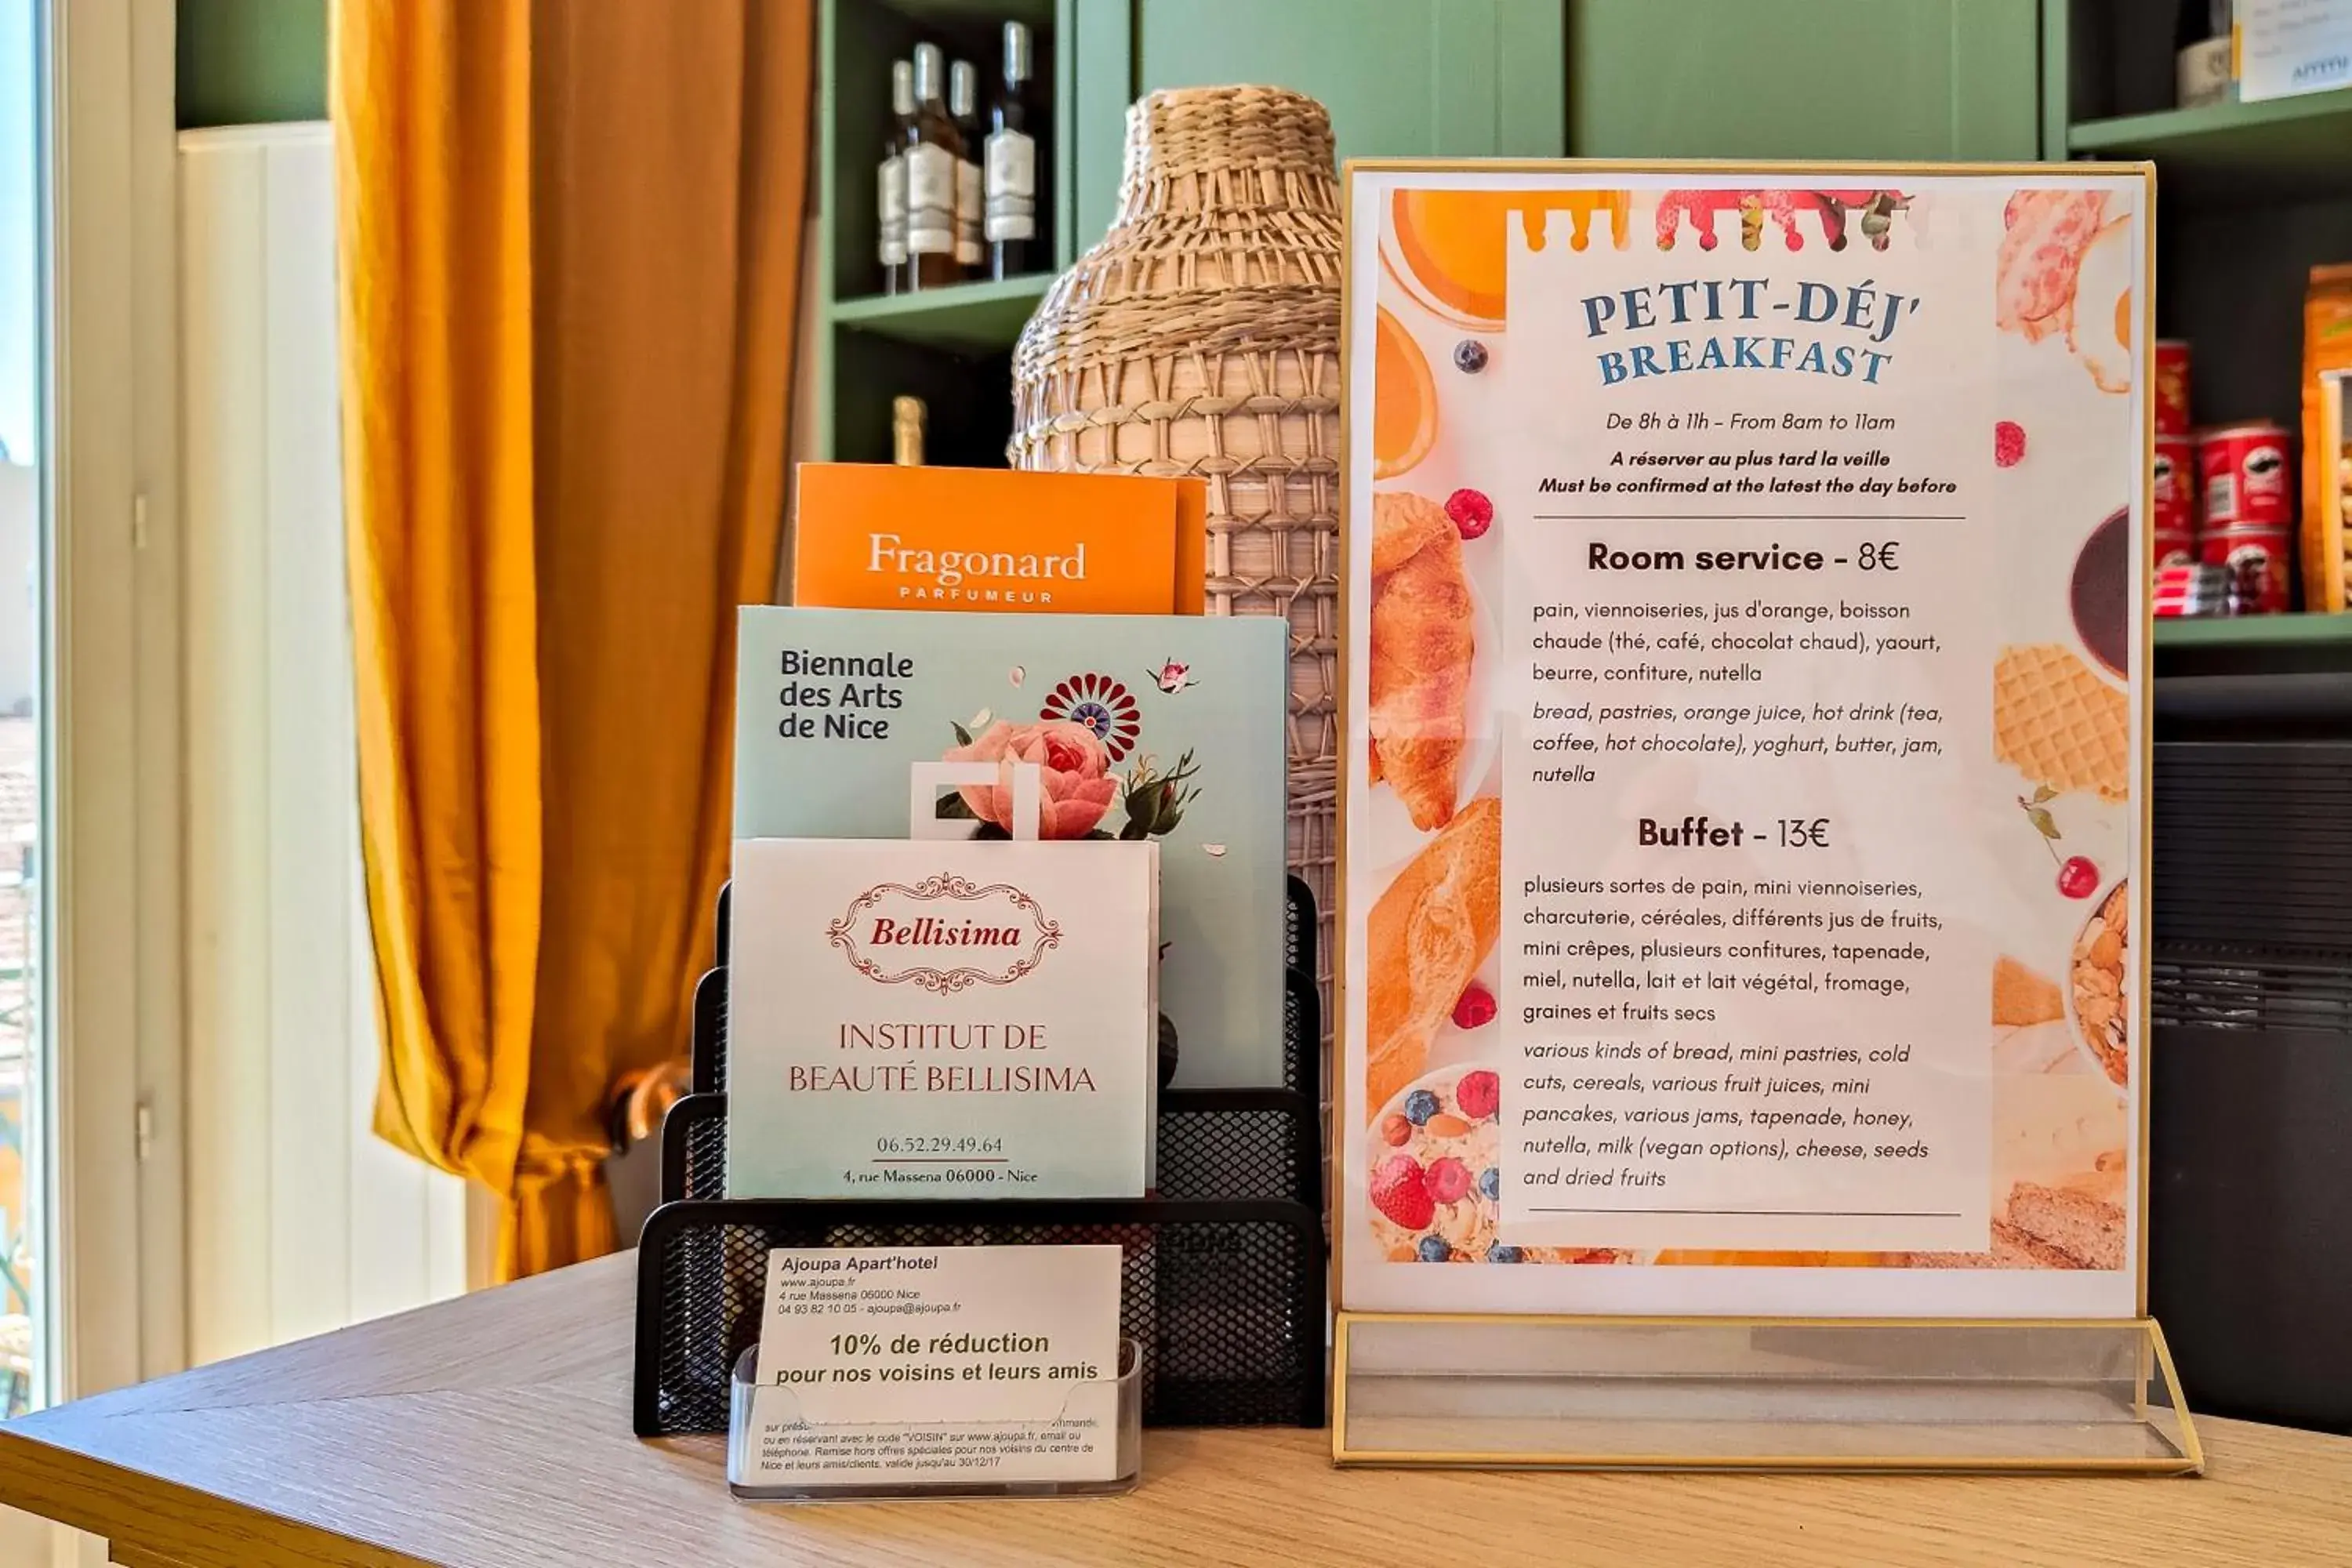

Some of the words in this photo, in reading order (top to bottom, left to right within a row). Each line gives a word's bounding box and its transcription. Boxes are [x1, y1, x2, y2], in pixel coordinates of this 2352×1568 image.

[1597, 336, 1893, 387] BREAKFAST
[1606, 412, 1632, 430] De
[1638, 412, 1661, 430] 8h
[1667, 413, 1679, 430] à
[1686, 412, 1708, 430] 11h
[1730, 412, 1776, 430] From
[1781, 412, 1823, 430] 8am
[1829, 414, 1848, 430] to
[1854, 412, 1895, 430] 11am
[1610, 451, 1624, 466] A
[1628, 451, 1705, 466] réserver
[1708, 455, 1732, 466] au
[1734, 450, 1773, 470] plus
[1778, 450, 1818, 466] tard
[1820, 450, 1838, 466] la
[1843, 450, 1890, 466] veille
[1537, 477, 1585, 493] Must
[1588, 477, 1612, 492] be
[1616, 477, 1710, 493] confirmed
[1712, 479, 1733, 492] at
[1736, 477, 1765, 492] the
[1769, 477, 1822, 493] latest
[1825, 477, 1854, 493] the
[1859, 477, 1893, 497] day
[1896, 477, 1957, 493] before
[867, 533, 1087, 588] Fragonard
[1588, 542, 1684, 570] Room
[1694, 543, 1824, 571] service
[1857, 541, 1900, 571] 8€
[898, 586, 1051, 603] PARFUMEUR
[1533, 602, 1578, 622] pain,
[1584, 601, 1708, 621] viennoiseries,
[1712, 602, 1739, 622] jus
[1744, 601, 1833, 622] d'orange,
[1840, 601, 1910, 619] boisson
[1532, 631, 1602, 649] chaude
[1608, 632, 1650, 655] (thé,
[1656, 632, 1704, 652] café,
[1711, 633, 1794, 650] chocolat
[1799, 633, 1870, 655] chaud),
[1875, 635, 1940, 655] yaourt,
[781, 649, 913, 678] Biennale
[1533, 663, 1598, 683] beurre,
[1603, 663, 1693, 684] confiture,
[1699, 663, 1762, 681] nutella
[779, 681, 831, 707] des
[838, 683, 903, 709] Arts
[779, 712, 815, 739] de
[824, 712, 889, 739] Nice
[1533, 702, 1592, 722] bread,
[1599, 704, 1677, 724] pastries,
[1683, 707, 1751, 725] orange
[1752, 704, 1806, 725] juice,
[1812, 702, 1844, 720] hot
[1849, 703, 1895, 720] drink
[1900, 703, 1942, 725] (tea,
[1532, 734, 1599, 753] coffee,
[1605, 734, 1637, 751] hot
[1641, 734, 1747, 756] chocolate),
[1751, 735, 1828, 757] yoghurt,
[1835, 735, 1896, 755] butter,
[1900, 737, 1942, 758] jam,
[1532, 765, 1595, 782] nutella
[1639, 815, 1744, 847] Buffet
[1777, 818, 1830, 848] 13€
[1524, 877, 1604, 898] plusieurs
[1610, 877, 1666, 894] sortes
[1671, 877, 1695, 894] de
[1702, 879, 1748, 899] pain,
[1754, 879, 1791, 895] mini
[1797, 880, 1922, 898] viennoiseries,
[869, 917, 1021, 946] Bellisima
[1523, 908, 1635, 927] charcuterie,
[1641, 908, 1726, 928] céréales,
[1732, 909, 1824, 928] différents
[1828, 911, 1854, 930] jus
[1860, 909, 1884, 927] de
[1890, 909, 1942, 931] fruits,
[1523, 940, 1560, 956] mini
[1566, 939, 1635, 961] crêpes,
[1641, 939, 1722, 962] plusieurs
[1727, 940, 1826, 961] confitures,
[1831, 941, 1929, 964] tapenade,
[1523, 971, 1566, 989] miel,
[1572, 971, 1640, 991] nutella,
[1646, 971, 1676, 989] lait
[1682, 973, 1701, 989] et
[1707, 971, 1737, 989] lait
[1741, 972, 1818, 994] végétal,
[1824, 972, 1909, 995] fromage,
[1523, 1004, 1592, 1024] graines
[1597, 1004, 1617, 1020] et
[1622, 1003, 1668, 1020] fruits
[1674, 1008, 1715, 1021] secs
[840, 1023, 995, 1050] INSTITUT
[1004, 1024, 1047, 1051] DE
[1524, 1042, 1589, 1058] various
[1595, 1042, 1642, 1059] kinds
[1647, 1042, 1668, 1059] of
[1672, 1042, 1733, 1063] bread,
[1740, 1045, 1778, 1061] mini
[1782, 1045, 1861, 1065] pastries,
[1868, 1044, 1911, 1063] cold
[789, 1059, 918, 1091] BEAUTÉ
[927, 1065, 1096, 1092] BELLISIMA
[1523, 1074, 1566, 1092] cuts,
[1572, 1074, 1644, 1093] cereals,
[1652, 1076, 1718, 1092] various
[1724, 1075, 1762, 1092] fruit
[1763, 1076, 1824, 1098] juices,
[1831, 1078, 1870, 1094] mini
[1521, 1105, 1617, 1127] pancakes,
[1624, 1107, 1690, 1123] various
[1692, 1108, 1743, 1128] jams,
[1749, 1107, 1846, 1130] tapenade,
[1853, 1107, 1912, 1131] honey,
[877, 1135, 1001, 1154] 06.52.29.49.64
[1523, 1137, 1591, 1156] nutella,
[1597, 1138, 1634, 1154] milk
[1639, 1138, 1704, 1160] (vegan
[1709, 1139, 1788, 1161] options),
[1795, 1139, 1867, 1160] cheese,
[1873, 1140, 1929, 1158] seeds
[843, 1169, 855, 1185] 4,
[858, 1174, 880, 1182] rue
[883, 1169, 943, 1183] Massena
[946, 1167, 995, 1183] 06000
[1007, 1169, 1038, 1182] Nice
[1523, 1168, 1560, 1185] and
[1565, 1168, 1614, 1186] dried
[1621, 1169, 1666, 1186] fruits
[780, 1257, 840, 1274] Ajoupa
[845, 1255, 938, 1272] Apart'hotel
[780, 1276, 855, 1288] www.ajoupa.fr
[829, 1333, 881, 1356] 10%
[890, 1334, 920, 1354] de
[929, 1332, 1048, 1354] réduction
[775, 1368, 827, 1386] pour
[832, 1368, 872, 1382] nos
[878, 1363, 955, 1381] voisins
[962, 1363, 982, 1381] et
[989, 1362, 1040, 1381] leurs
[1047, 1360, 1098, 1382] amis
